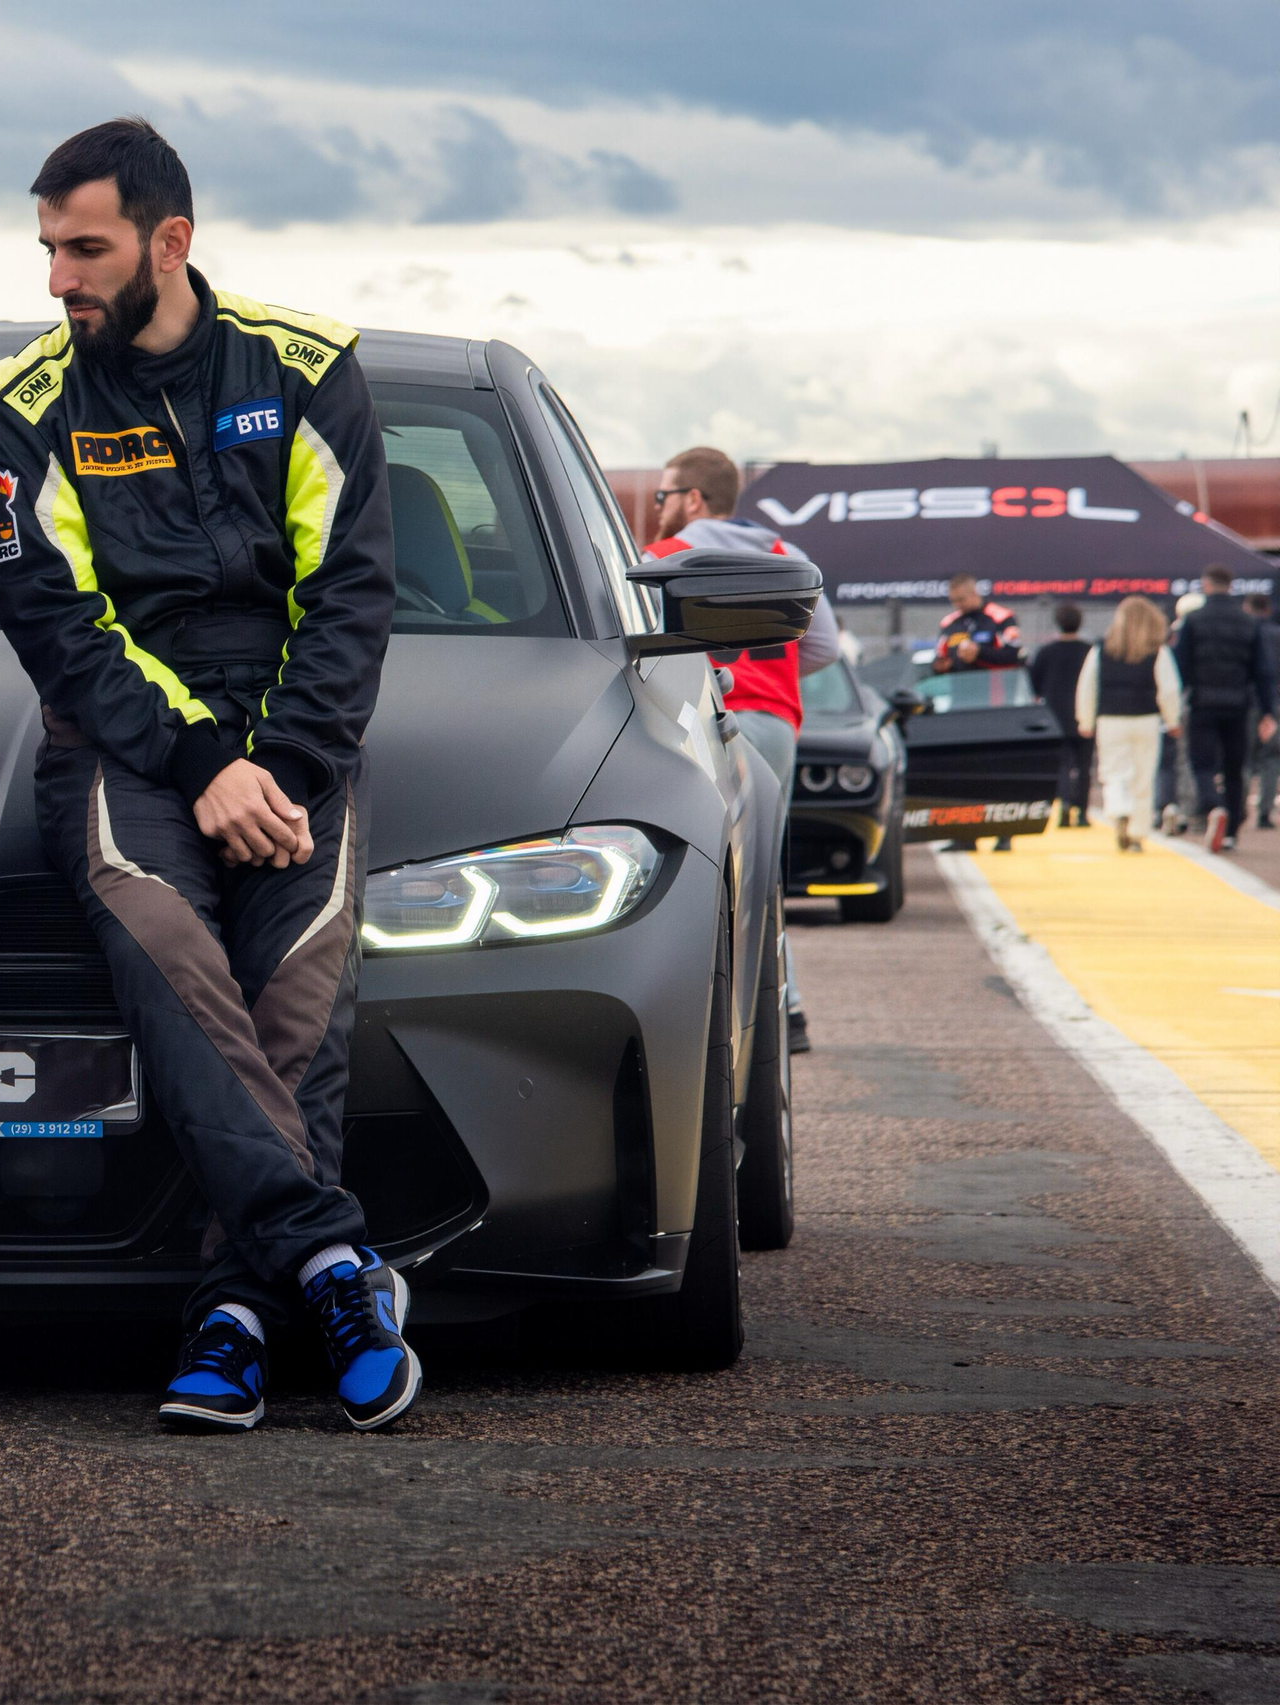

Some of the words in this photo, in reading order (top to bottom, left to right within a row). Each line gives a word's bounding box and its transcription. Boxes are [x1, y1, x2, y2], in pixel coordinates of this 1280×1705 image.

[284, 342, 325, 367] OMP
[19, 372, 52, 405] OMP
[235, 408, 280, 435] ВТБ
[75, 430, 170, 465] RDRC
[756, 486, 1141, 527] VISSOL
[10, 1123, 32, 1136] (29)
[37, 1123, 46, 1135] 3
[48, 1123, 71, 1135] 912
[73, 1123, 97, 1135] 912
